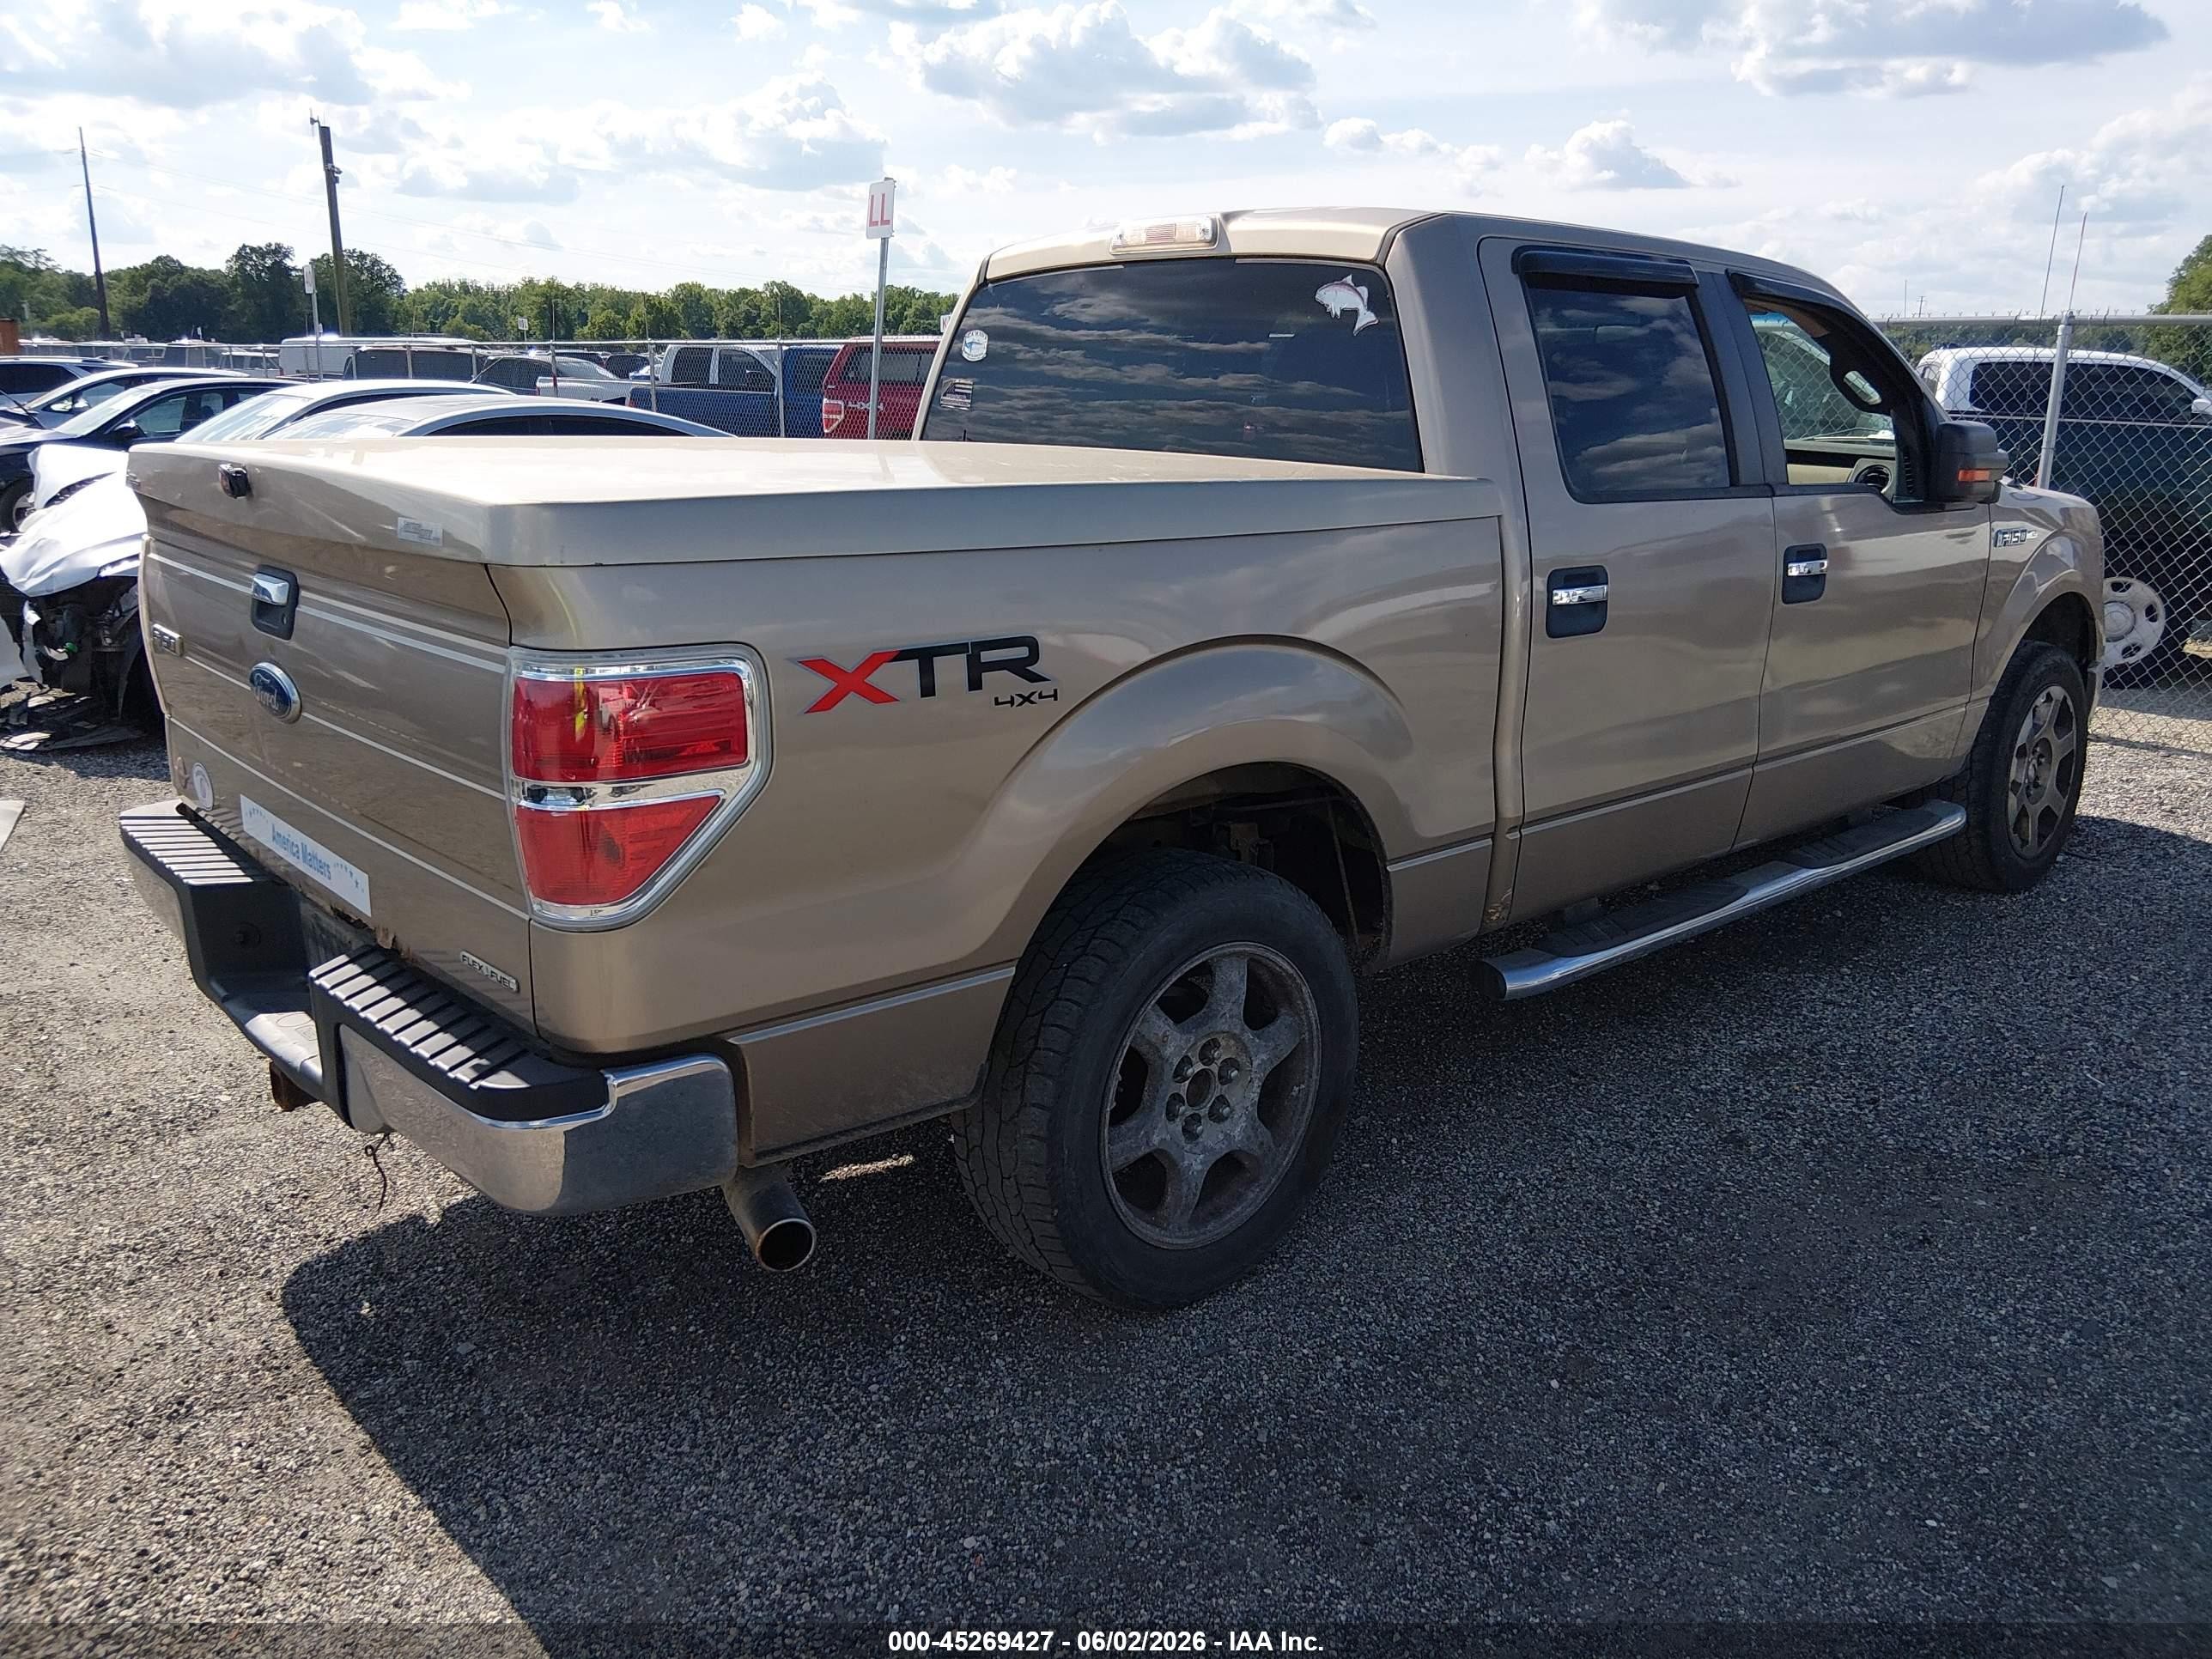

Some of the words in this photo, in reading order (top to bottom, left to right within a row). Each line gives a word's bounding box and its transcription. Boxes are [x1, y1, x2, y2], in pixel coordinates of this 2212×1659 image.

[868, 192, 891, 228] LL
[254, 672, 281, 711] Ford
[796, 635, 1053, 714] XTR
[271, 823, 300, 860] America
[301, 842, 332, 881] Matters
[462, 953, 483, 970] FLEX
[490, 969, 514, 990] FUEL
